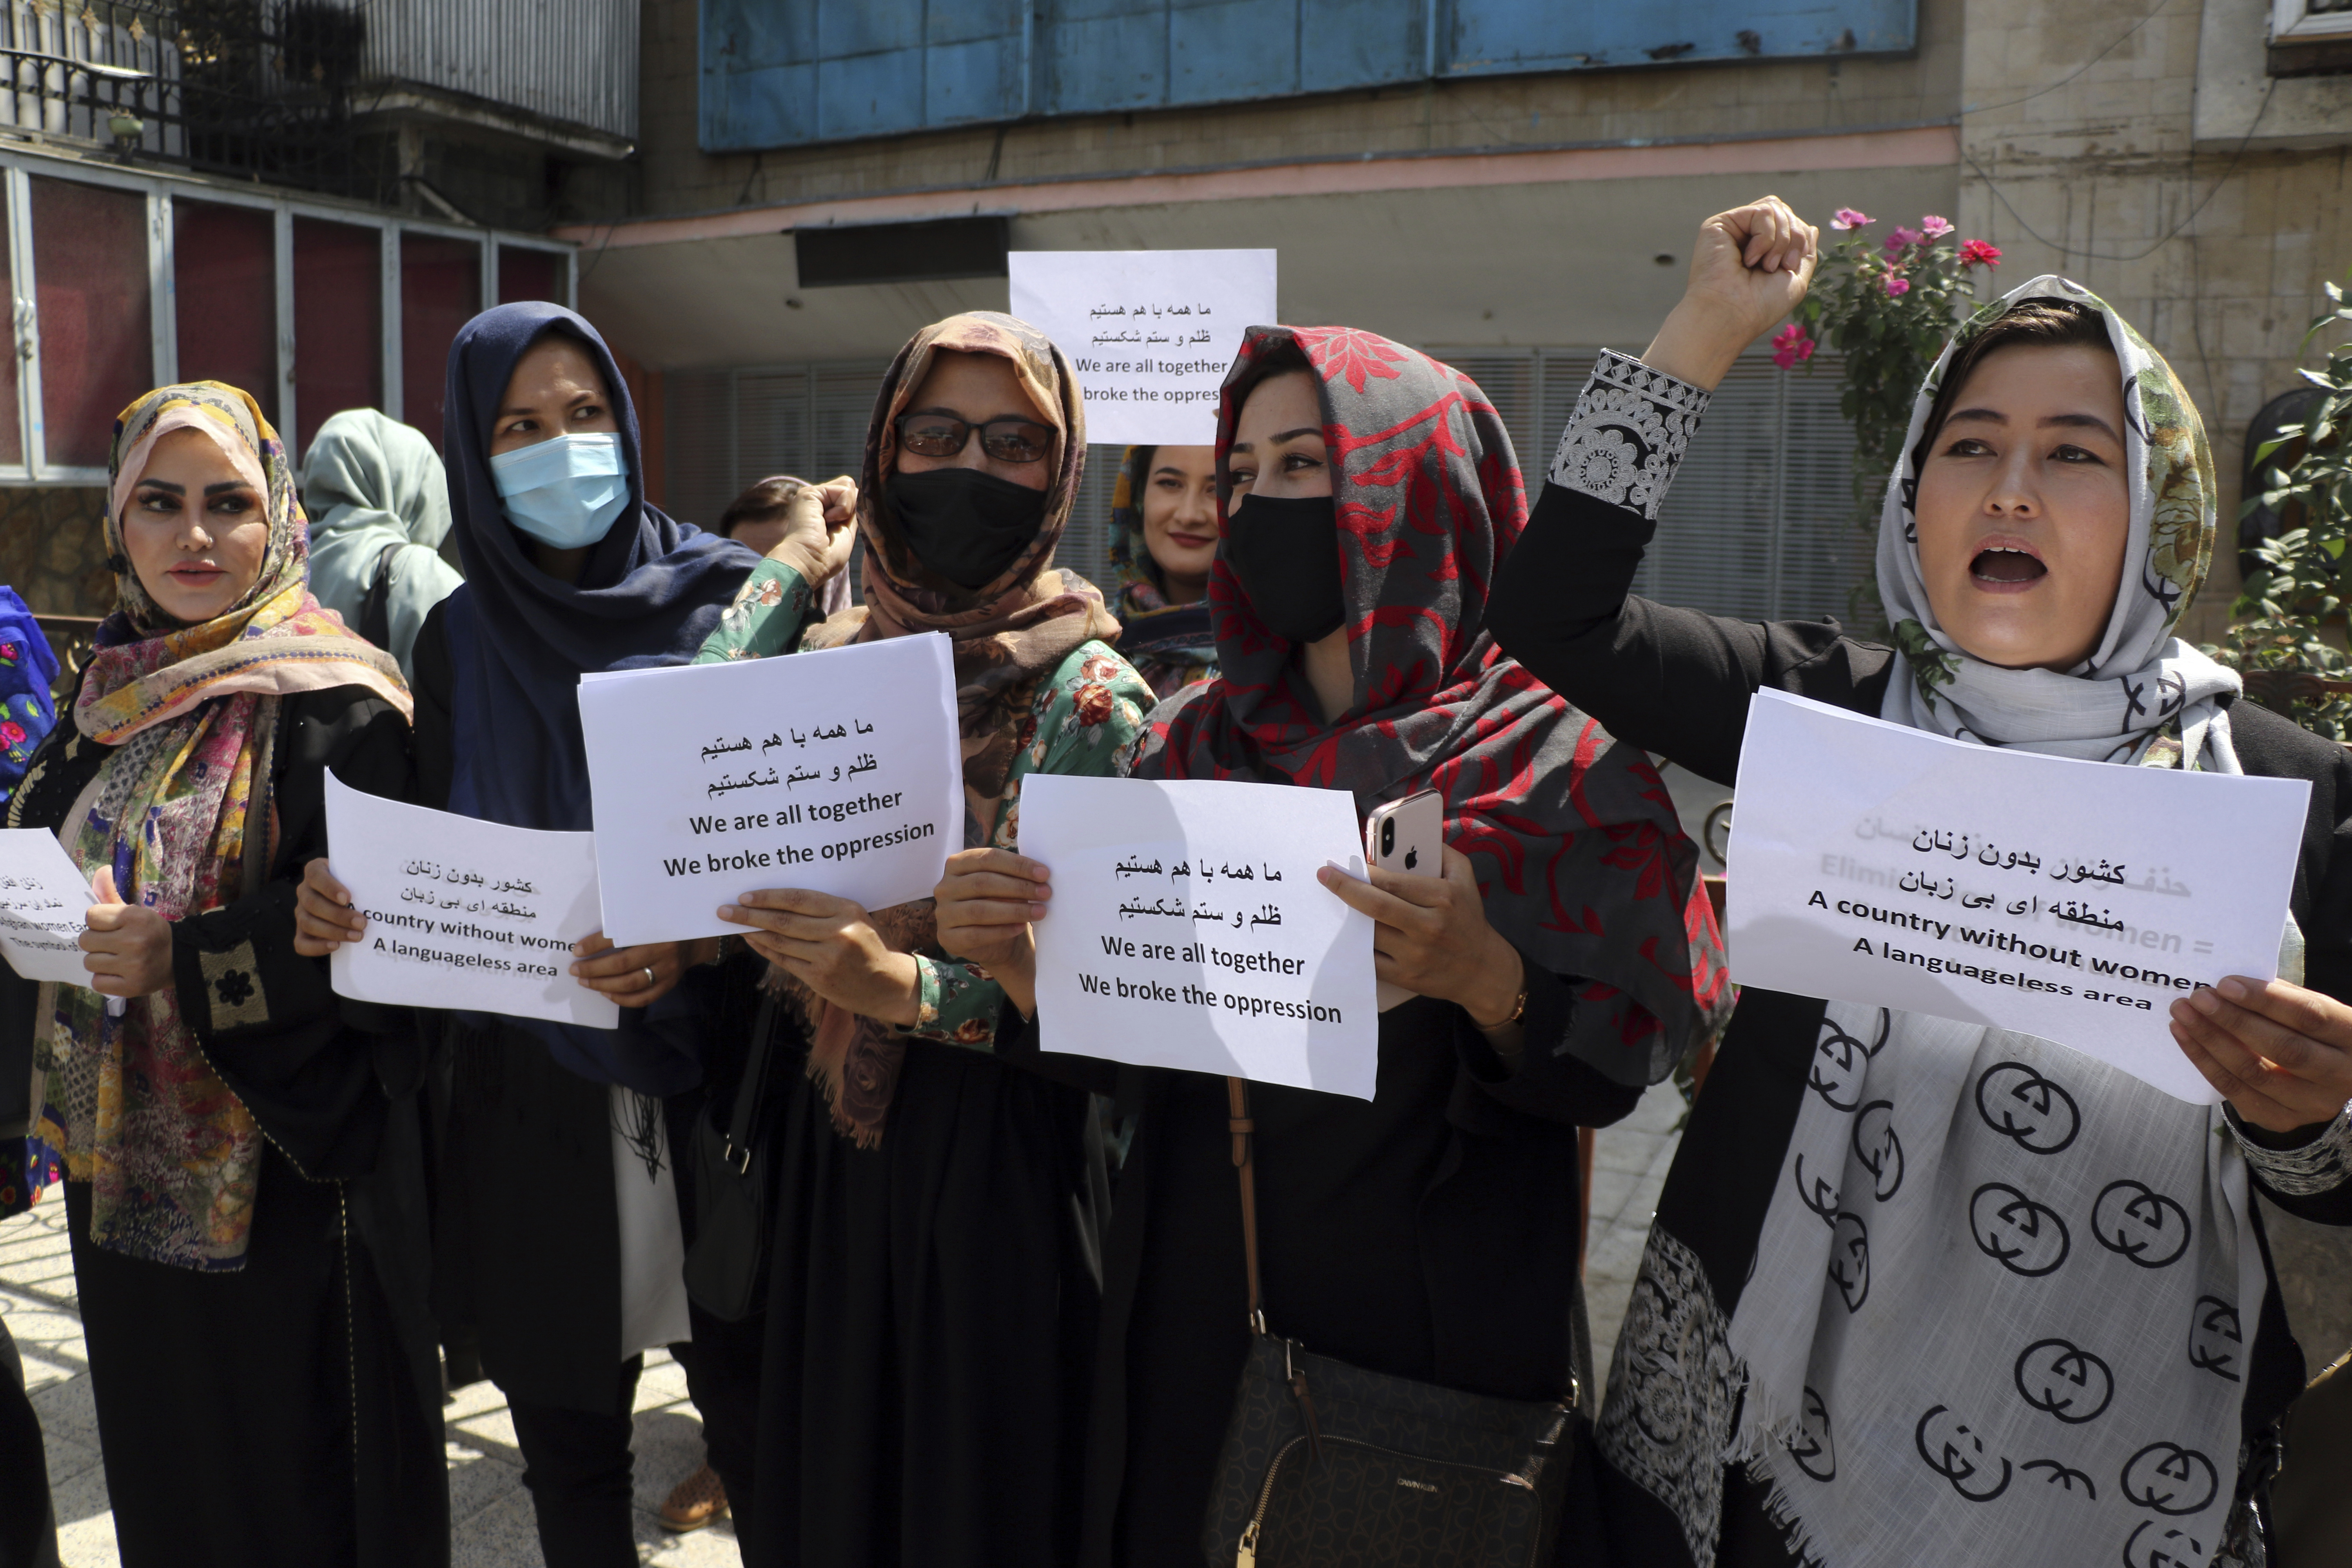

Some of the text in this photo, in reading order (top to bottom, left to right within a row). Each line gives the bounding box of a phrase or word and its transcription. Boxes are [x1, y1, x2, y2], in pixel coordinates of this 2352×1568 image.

[1090, 303, 1211, 321] ما همه با هم هستیم
[1092, 329, 1211, 348] ظلم و ستم شکستیم
[1076, 358, 1228, 376] We are all together
[1084, 387, 1220, 404] broke the oppres
[701, 719, 873, 763] ما همه با هم هستیم
[708, 753, 877, 800] ظلم و ستم شکستیم
[689, 792, 902, 835] We are all together
[663, 823, 934, 877] We broke the oppression
[1913, 829, 1968, 860] زنان
[1978, 844, 2040, 875] بدون
[407, 861, 532, 893] کشور بدون زنان
[1115, 855, 1282, 885] ما همه با هم هستیم
[2050, 859, 2125, 884] کشور
[401, 887, 536, 918] منطقه ای بی زبان
[1119, 897, 1281, 933] ظلم و ستم شکستیم
[1899, 871, 2124, 932] منطقه ای بی زبان
[9, 937, 33, 948] The
[31, 921, 72, 933] women
[363, 910, 435, 934] country
[441, 922, 514, 944] without
[520, 936, 576, 952] wome
[1808, 890, 1828, 909] A
[1837, 900, 1951, 940] country
[1960, 927, 2082, 967] without
[374, 938, 386, 951] A
[392, 940, 511, 970] languageless
[517, 963, 557, 976] area
[1101, 936, 1305, 975] We are all together
[1853, 938, 1873, 955] A
[1884, 942, 2073, 995] languageless
[2083, 990, 2152, 1010] area
[1078, 973, 1341, 1024] We broke the oppression
[1397, 1478, 1438, 1493] CALVIN KLEIN
